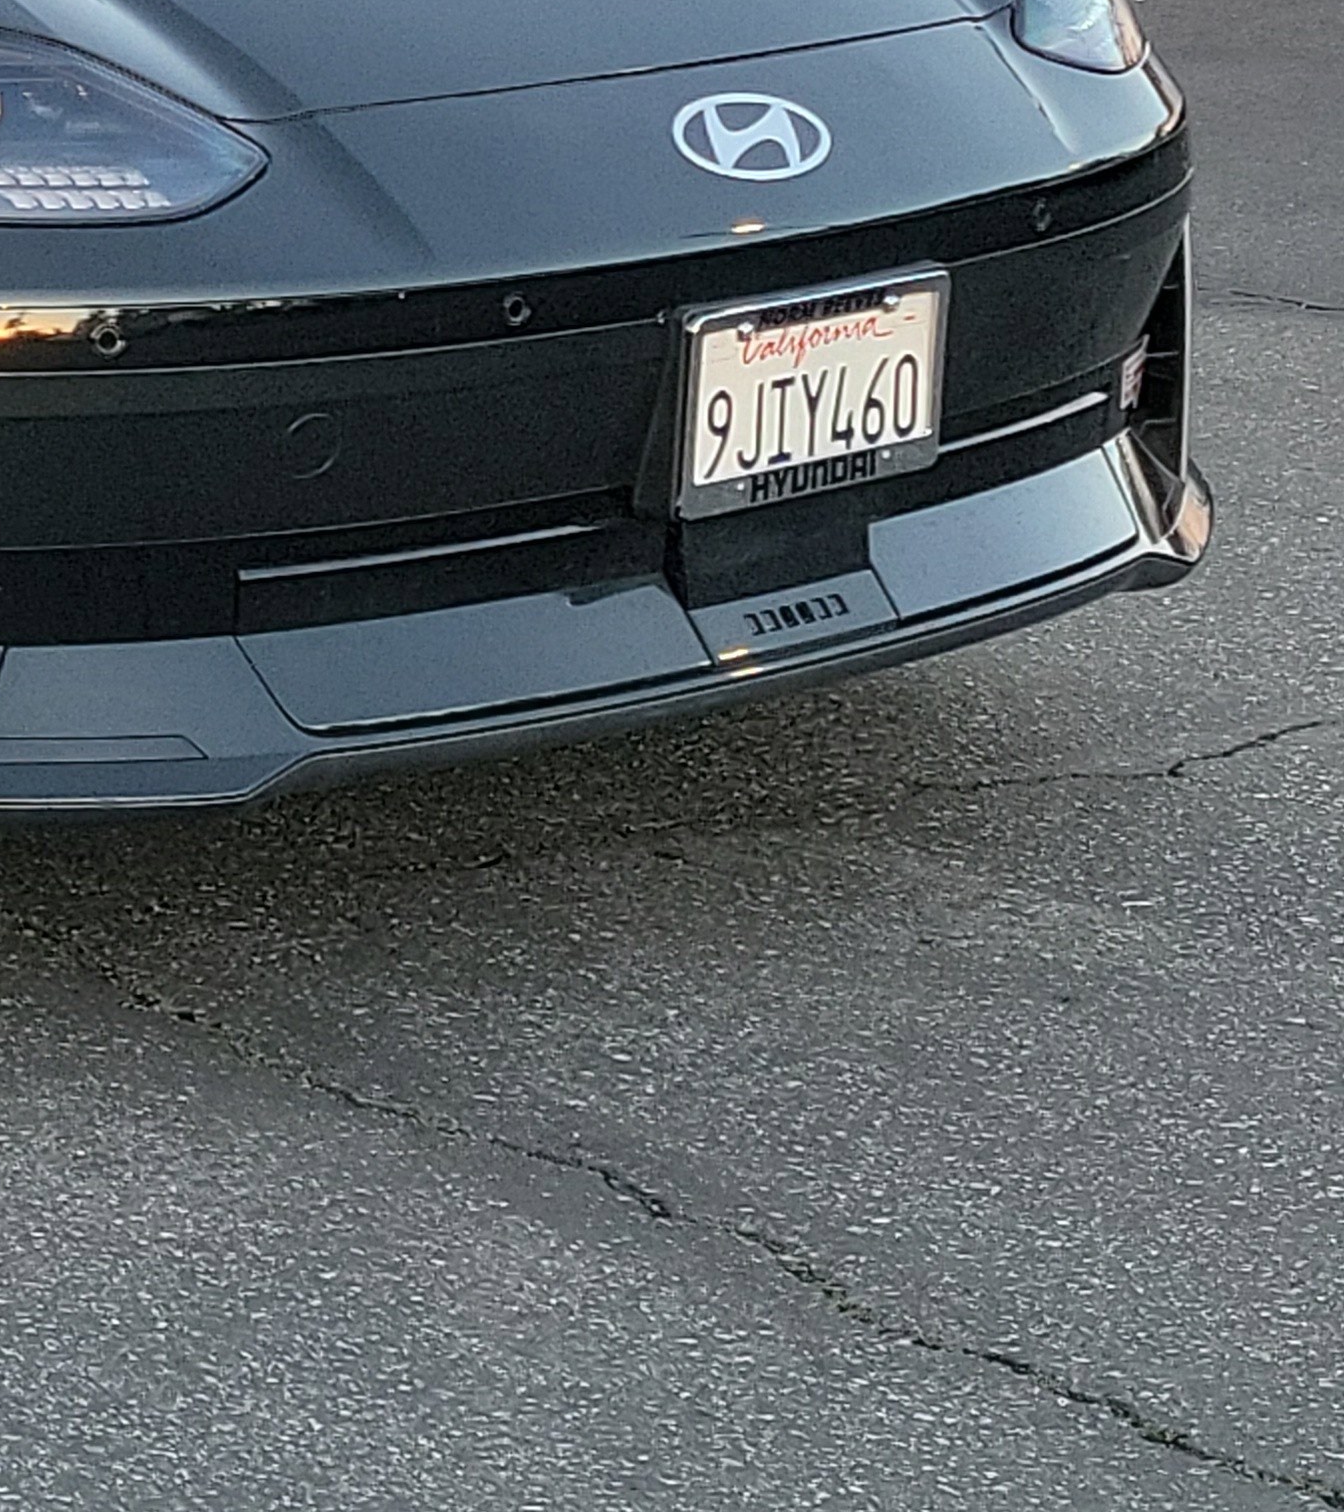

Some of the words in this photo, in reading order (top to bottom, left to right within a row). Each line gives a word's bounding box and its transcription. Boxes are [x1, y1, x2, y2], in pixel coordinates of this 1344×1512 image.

[741, 316, 894, 368] California
[703, 353, 919, 481] 9JIY460
[749, 450, 877, 503] HYUNDAI
